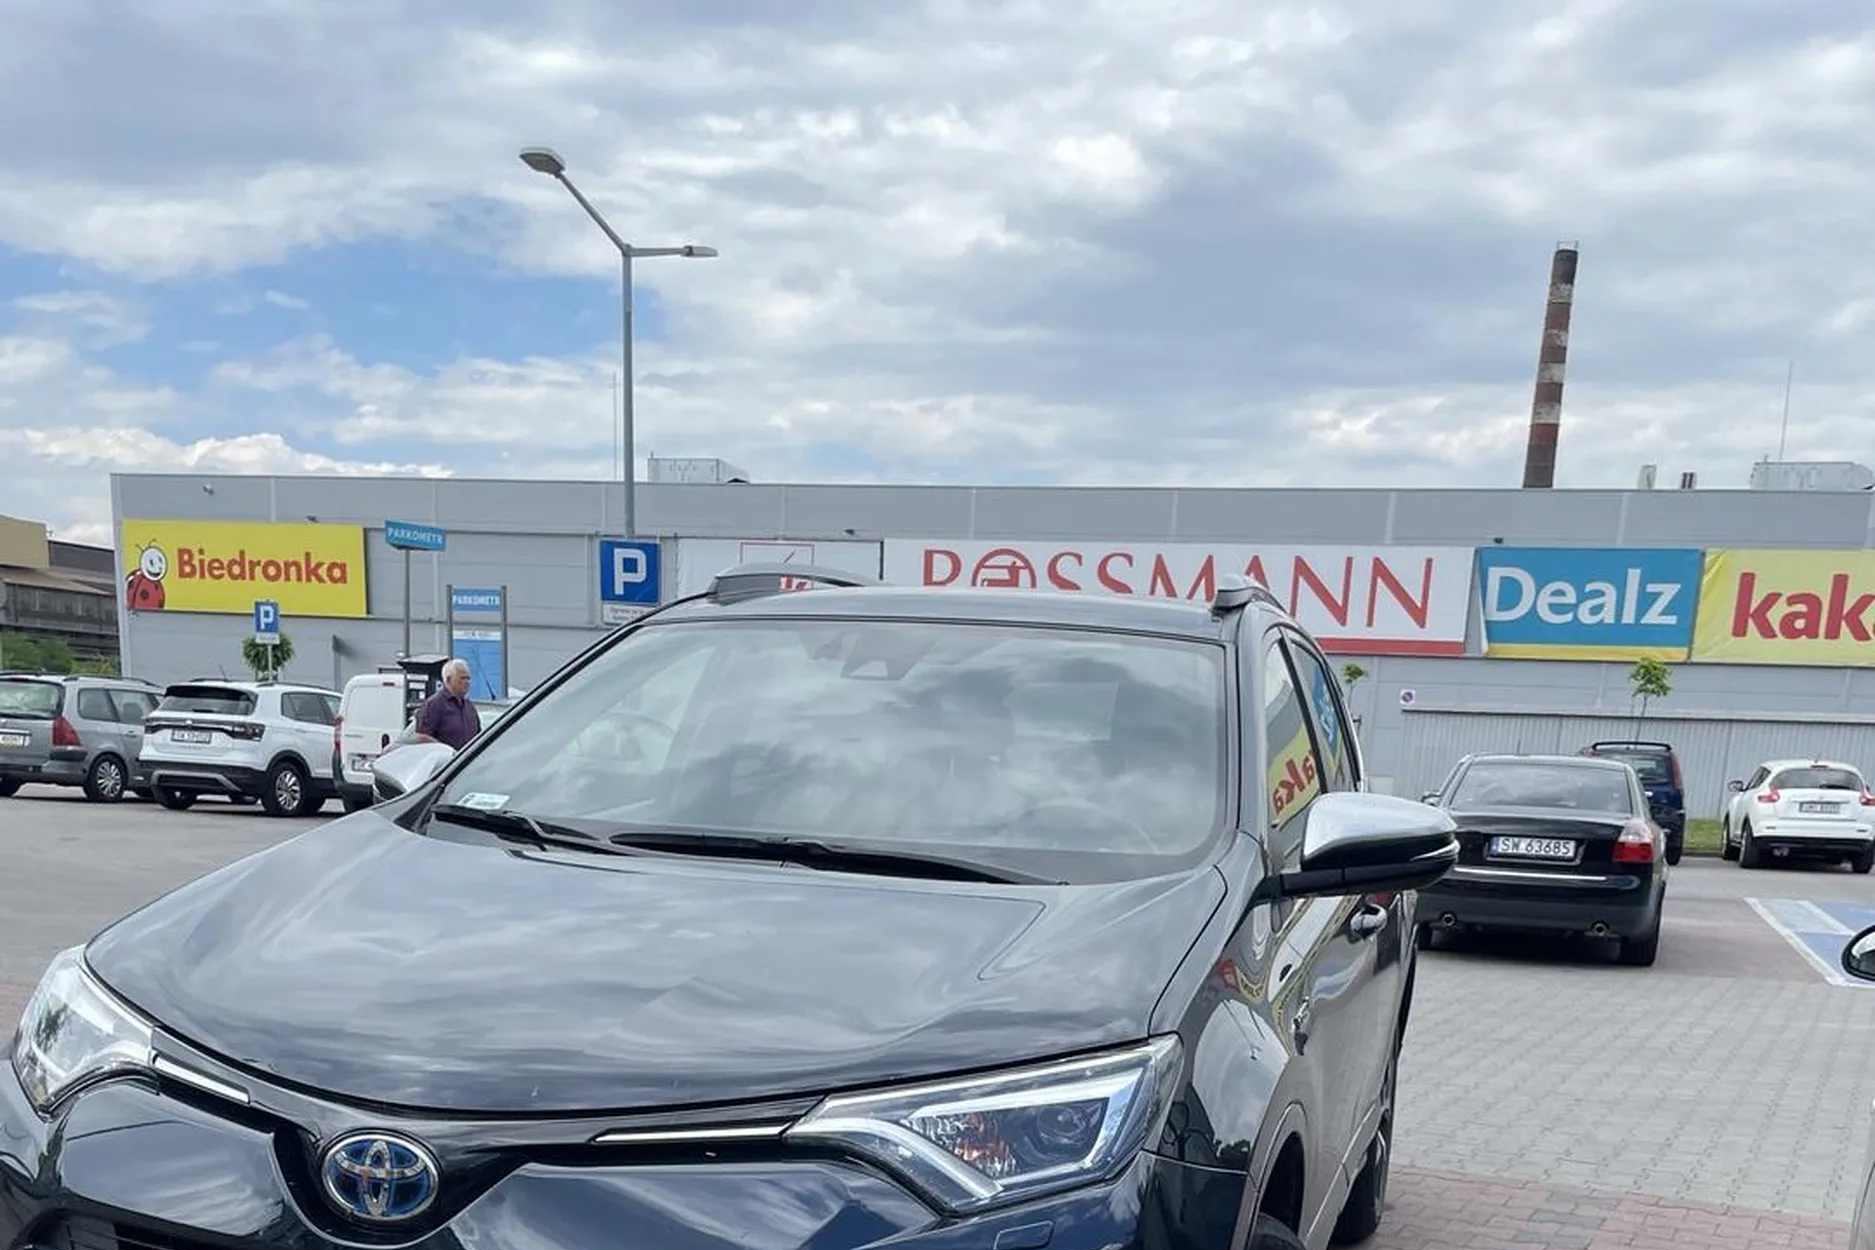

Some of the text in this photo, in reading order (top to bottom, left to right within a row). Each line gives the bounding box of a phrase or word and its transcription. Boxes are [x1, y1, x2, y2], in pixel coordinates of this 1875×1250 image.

[177, 547, 348, 584] Biedronka
[613, 547, 647, 595] P
[260, 604, 274, 629] P
[1485, 566, 1682, 625] Dealz
[1731, 571, 1875, 641] kak
[1501, 838, 1571, 855] SW 63685
